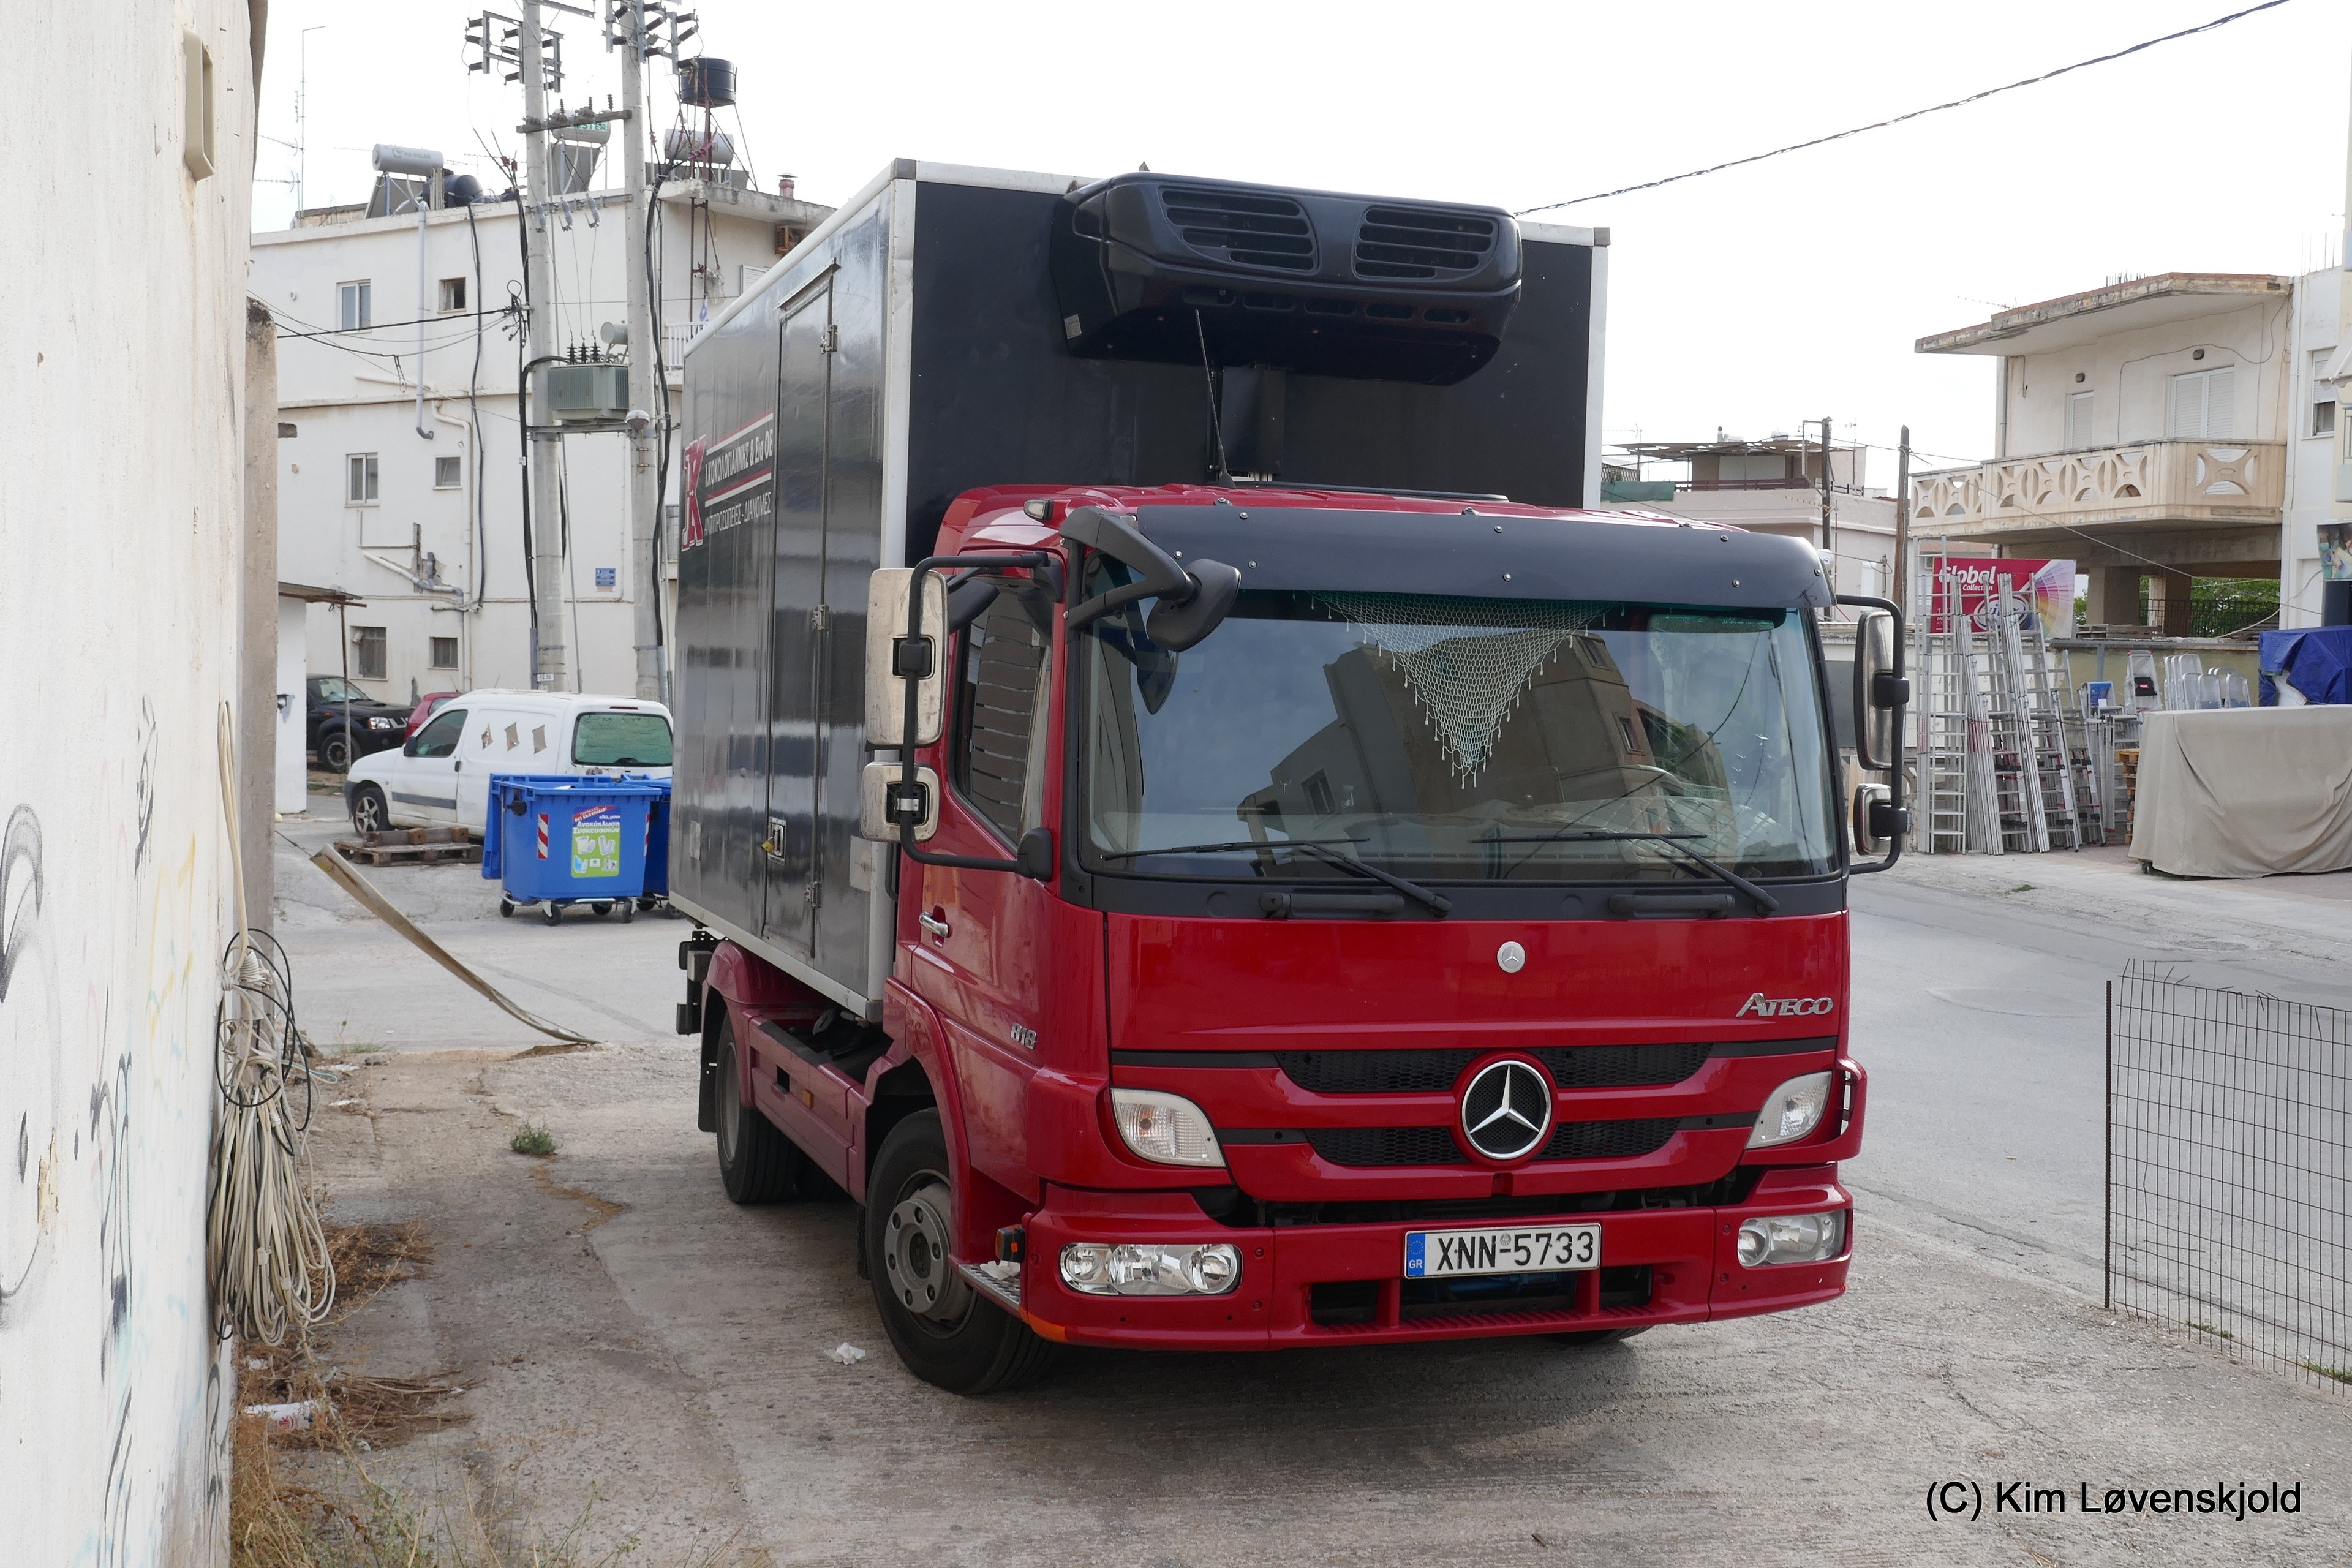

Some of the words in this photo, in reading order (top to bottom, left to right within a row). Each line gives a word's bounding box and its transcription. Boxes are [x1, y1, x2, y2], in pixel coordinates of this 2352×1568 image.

[750, 439, 755, 466] &
[744, 491, 771, 522] ΔΙΑΝΟΜΕΣ
[1409, 1259, 1422, 1269] GR
